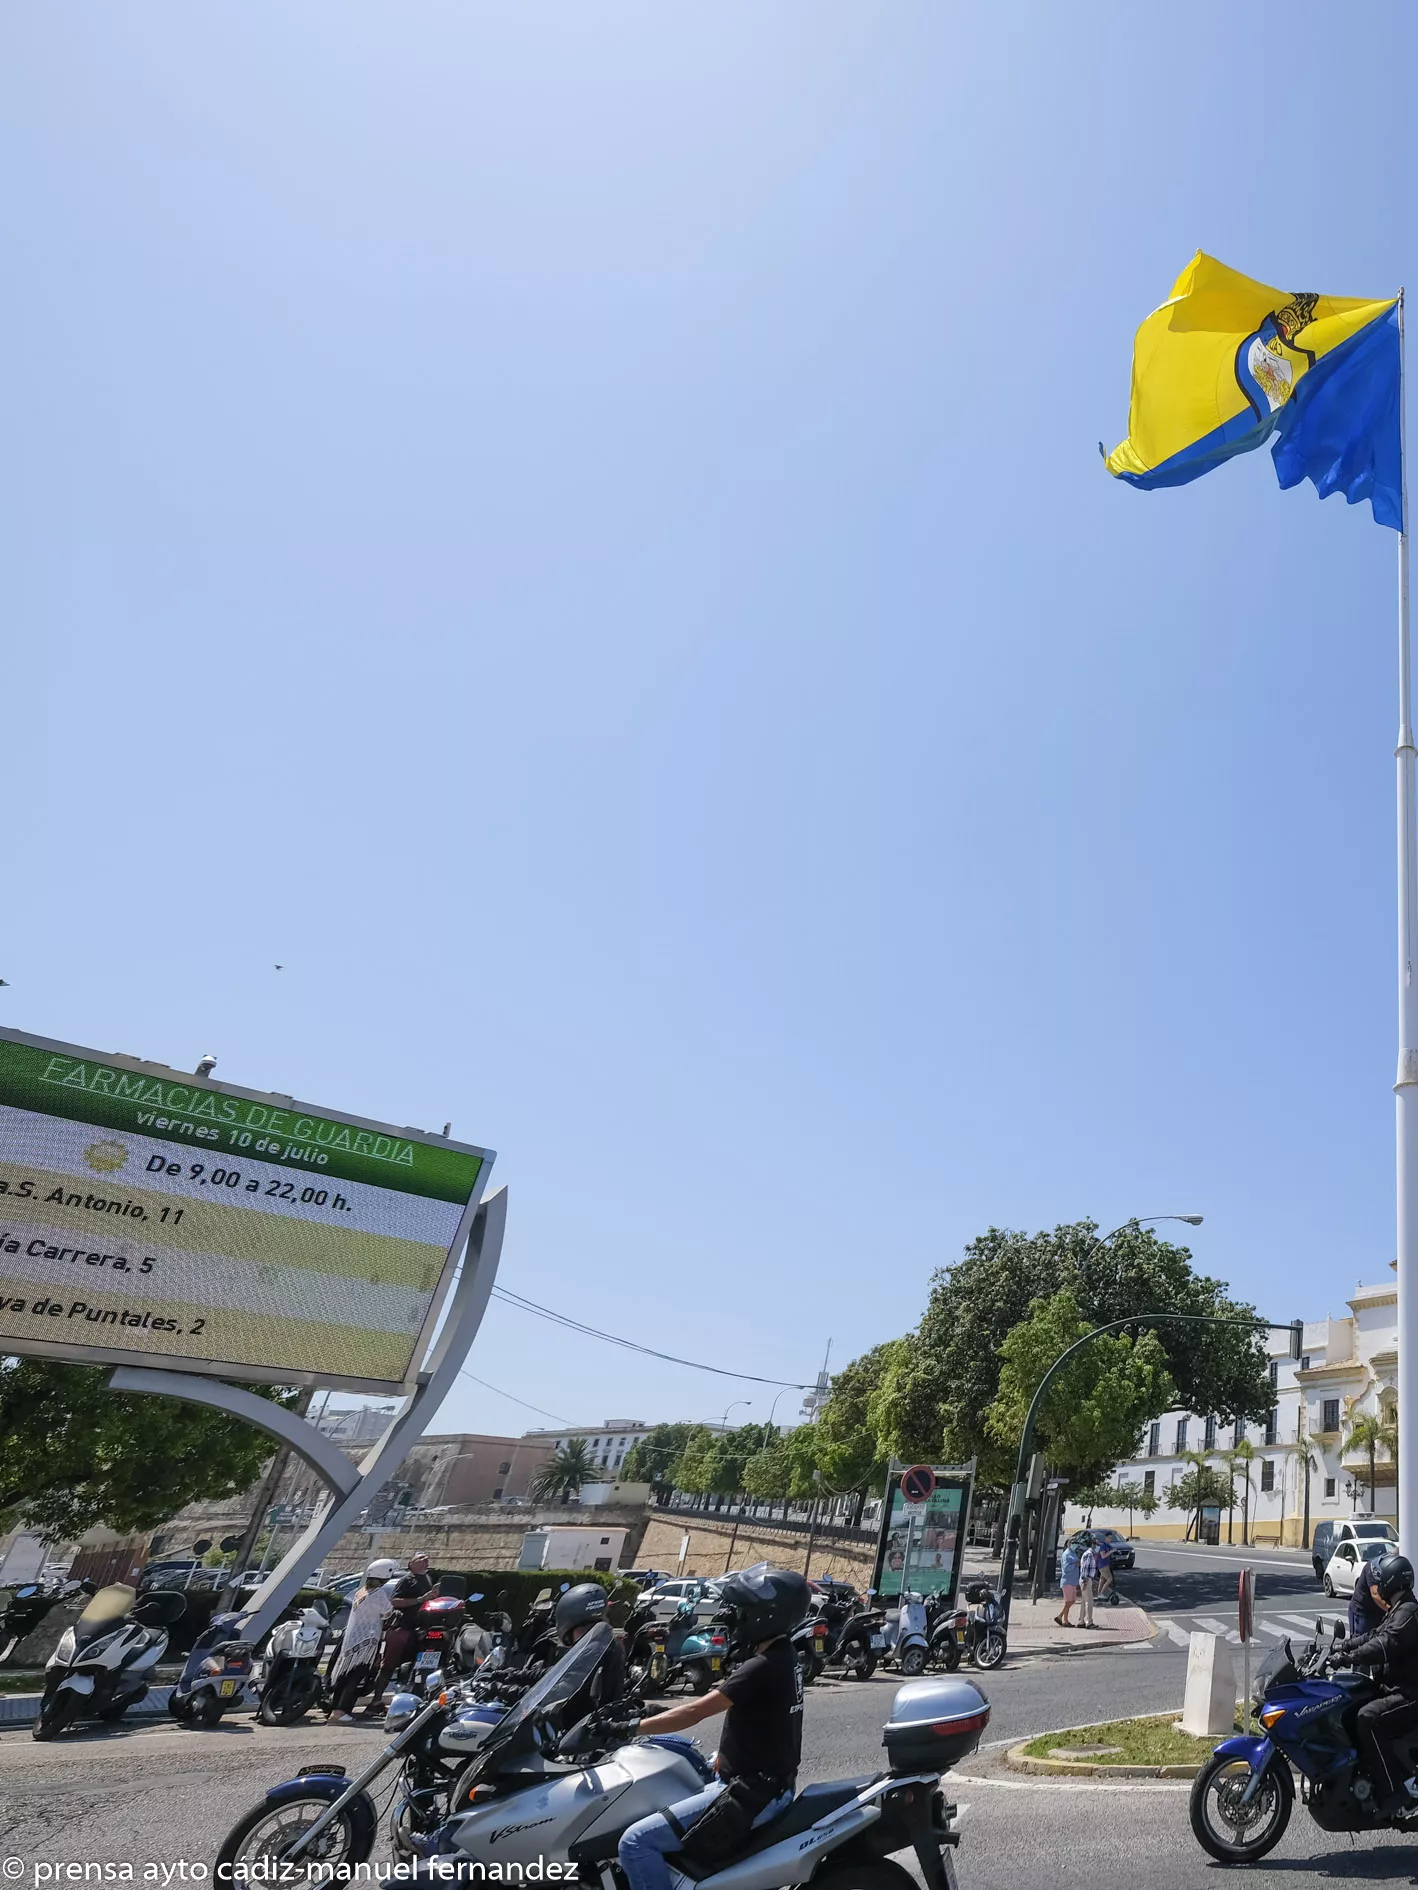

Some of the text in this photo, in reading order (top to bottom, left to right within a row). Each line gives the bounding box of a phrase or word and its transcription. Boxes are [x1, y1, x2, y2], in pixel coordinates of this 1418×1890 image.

[41, 1057, 414, 1165] FARMACIAS DE GUARDIA
[136, 1111, 330, 1166] viernes 10 de julio
[44, 1187, 149, 1222] Antonio,
[159, 1207, 185, 1225] 11
[145, 1154, 352, 1212] De 9,00 a 22,00 h.
[26, 1239, 132, 1273] Carrera,
[139, 1256, 157, 1274] 5
[31, 1297, 63, 1318] de
[67, 1301, 182, 1336] Puntales,
[189, 1318, 206, 1336] 2
